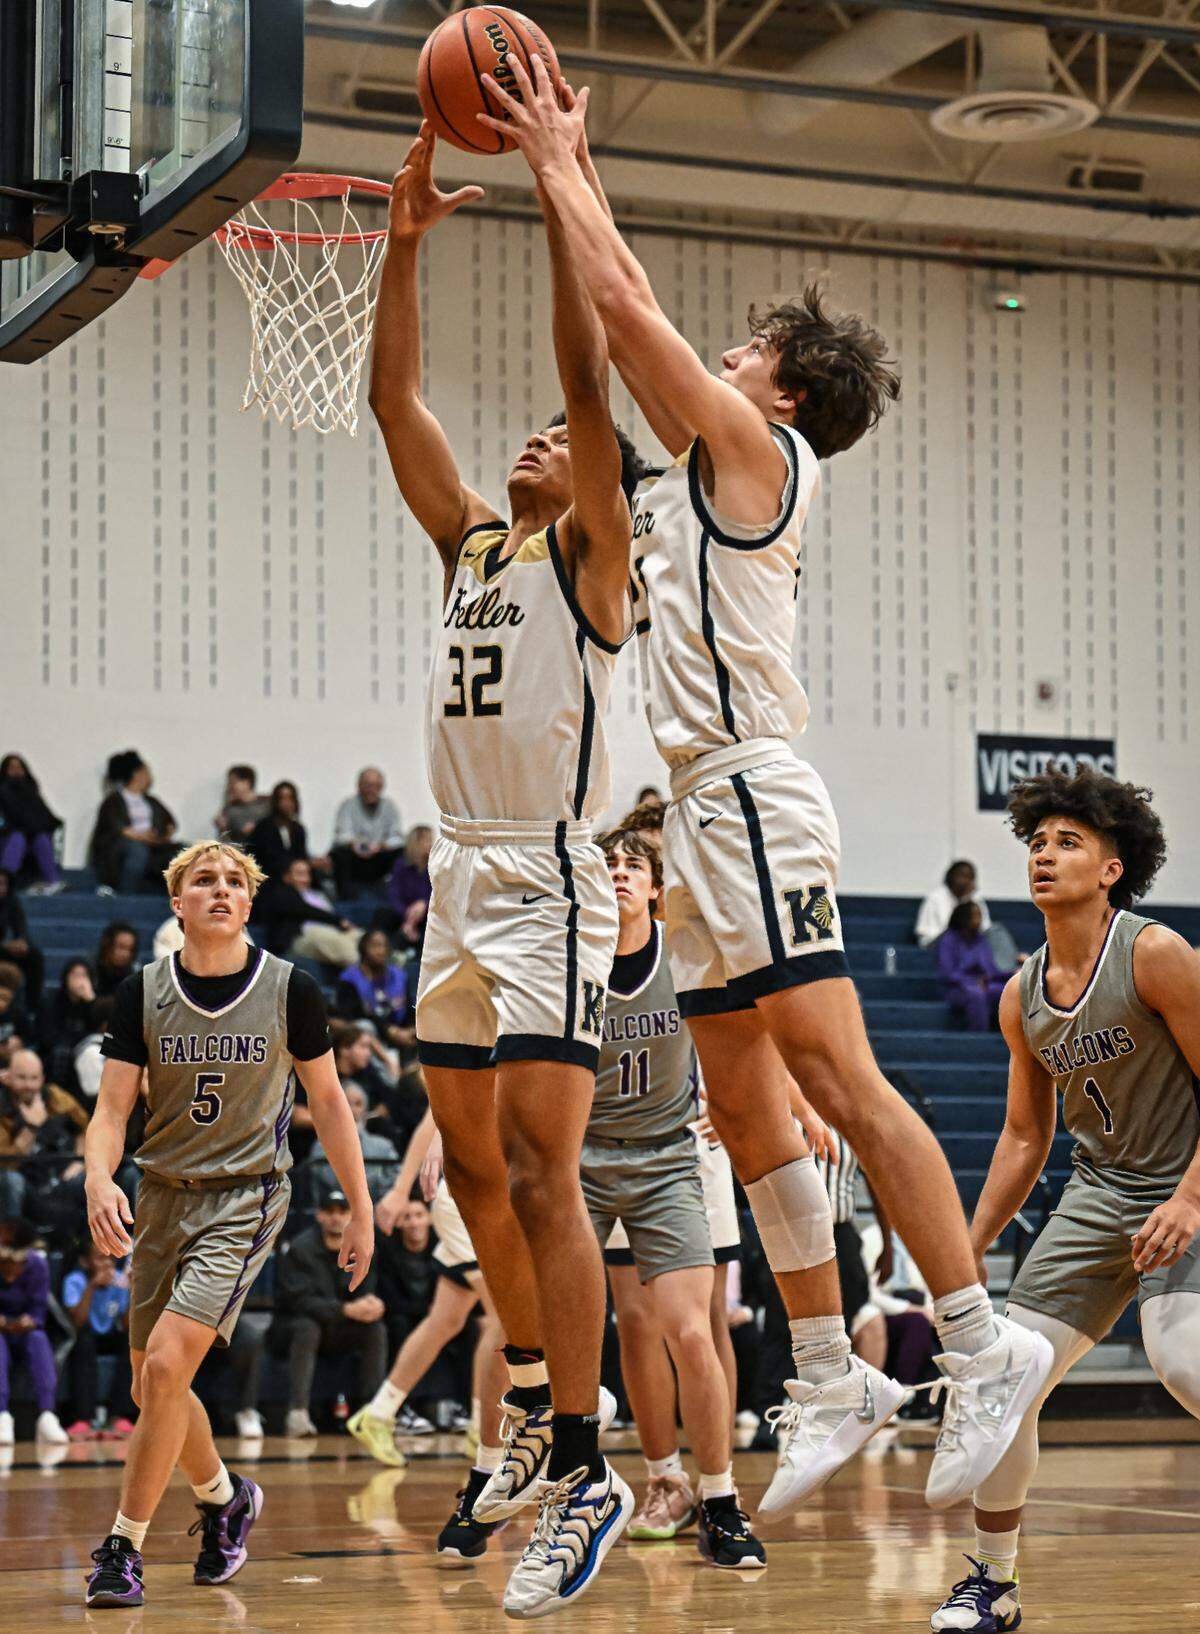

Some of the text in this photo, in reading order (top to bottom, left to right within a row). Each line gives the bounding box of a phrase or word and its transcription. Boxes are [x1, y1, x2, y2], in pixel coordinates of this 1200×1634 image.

[443, 645, 504, 717] 32
[159, 1033, 268, 1065] FALCONS
[601, 1008, 681, 1043] LCONS
[1040, 1025, 1136, 1077] FALCONS
[617, 1047, 650, 1097] 11
[189, 1072, 226, 1127] 5
[1083, 1076, 1114, 1135] 1
